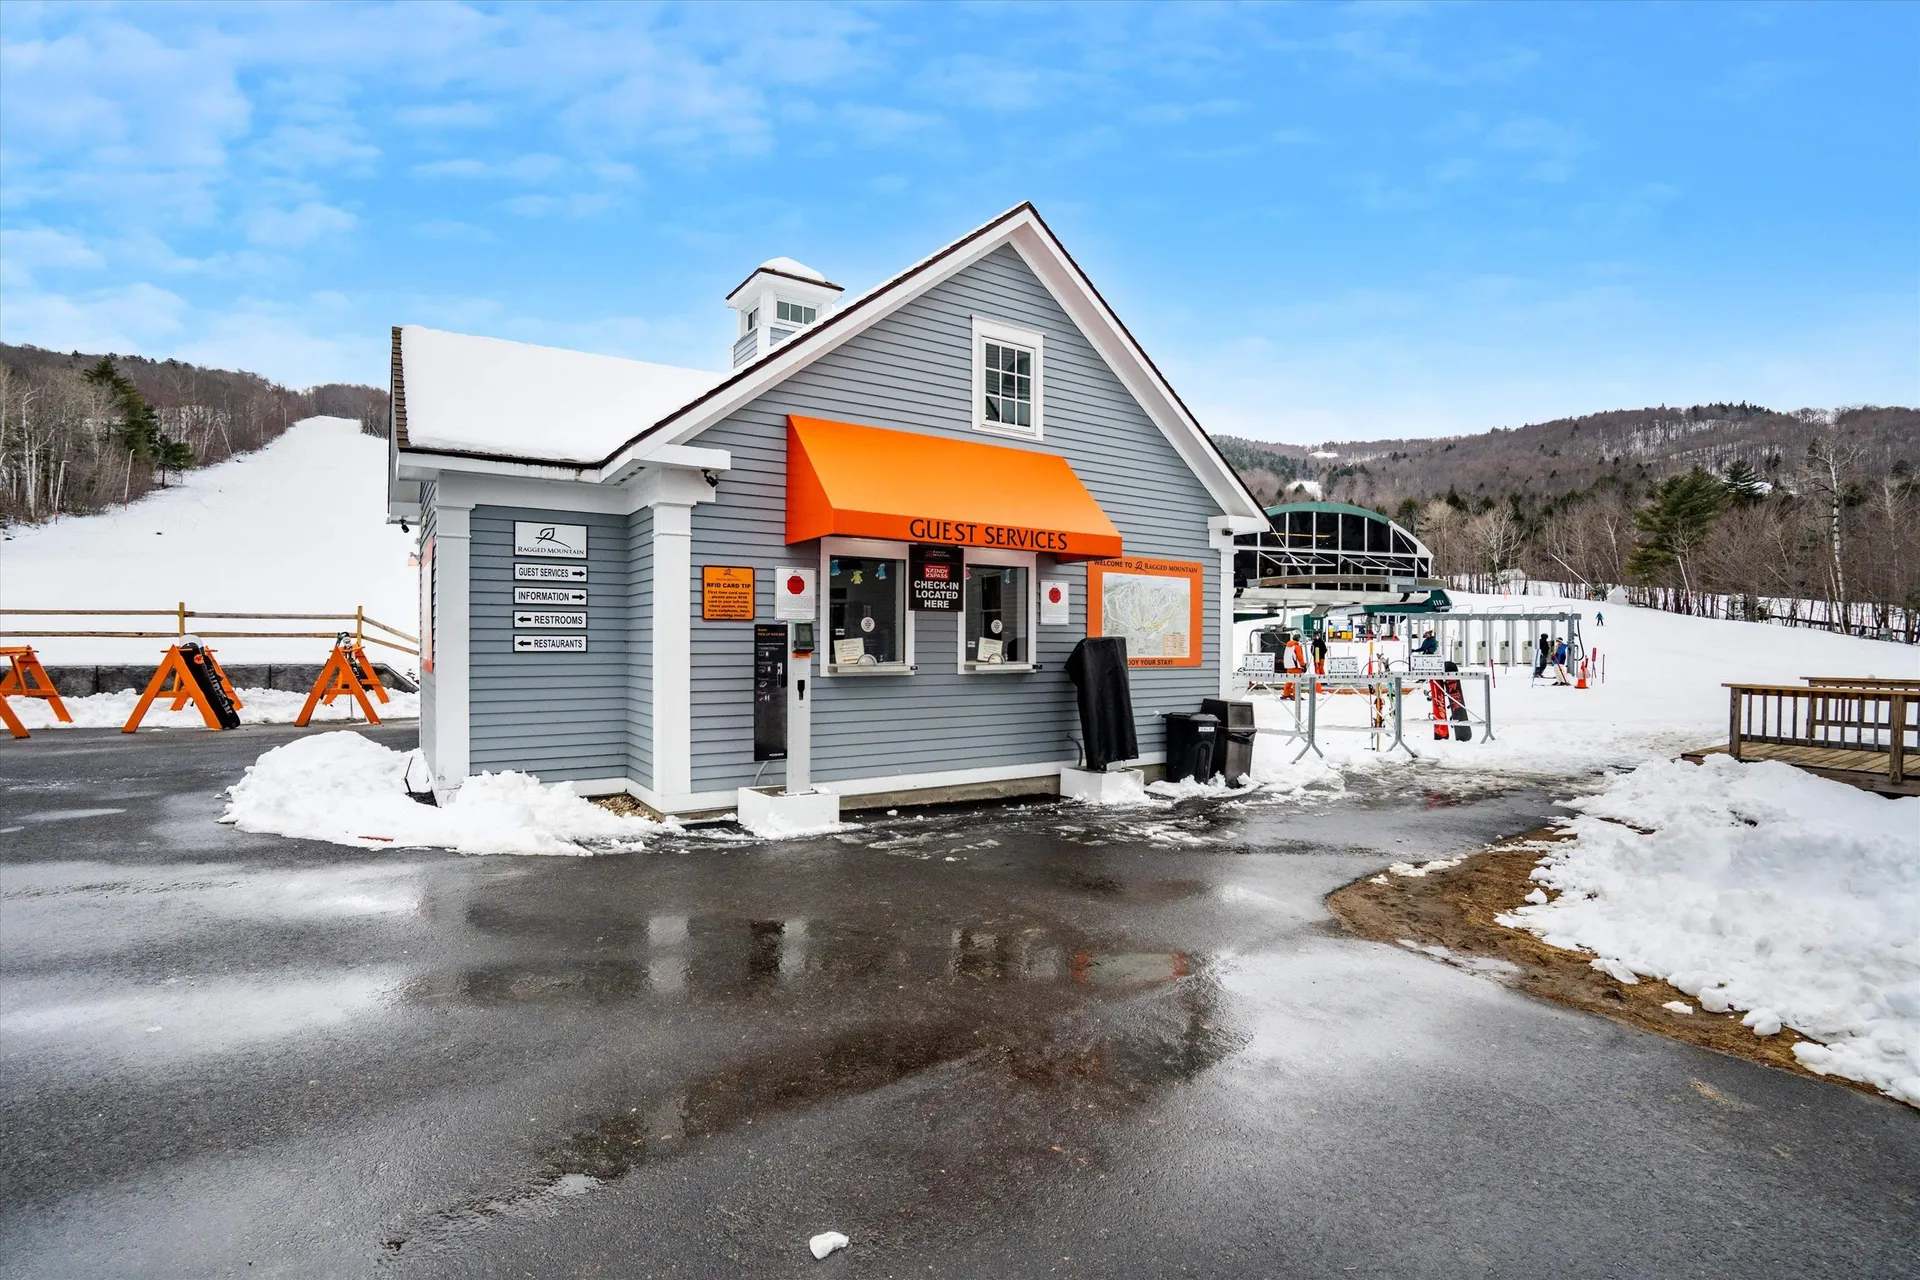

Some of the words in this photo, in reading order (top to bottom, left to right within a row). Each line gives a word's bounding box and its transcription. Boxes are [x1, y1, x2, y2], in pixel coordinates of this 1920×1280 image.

[909, 518, 977, 543] GUEST
[984, 526, 1068, 550] SERVICES
[1094, 560, 1123, 568] WELCOME
[518, 567, 539, 577] GUEST
[540, 568, 568, 578] SERVICES
[914, 580, 959, 590] CHECK-IN
[518, 591, 570, 601] INFORMATION
[916, 590, 958, 600] LOCATED
[924, 600, 950, 608] HERE
[534, 616, 583, 625] RESTROOMS
[534, 640, 582, 648] RESTAURANTS
